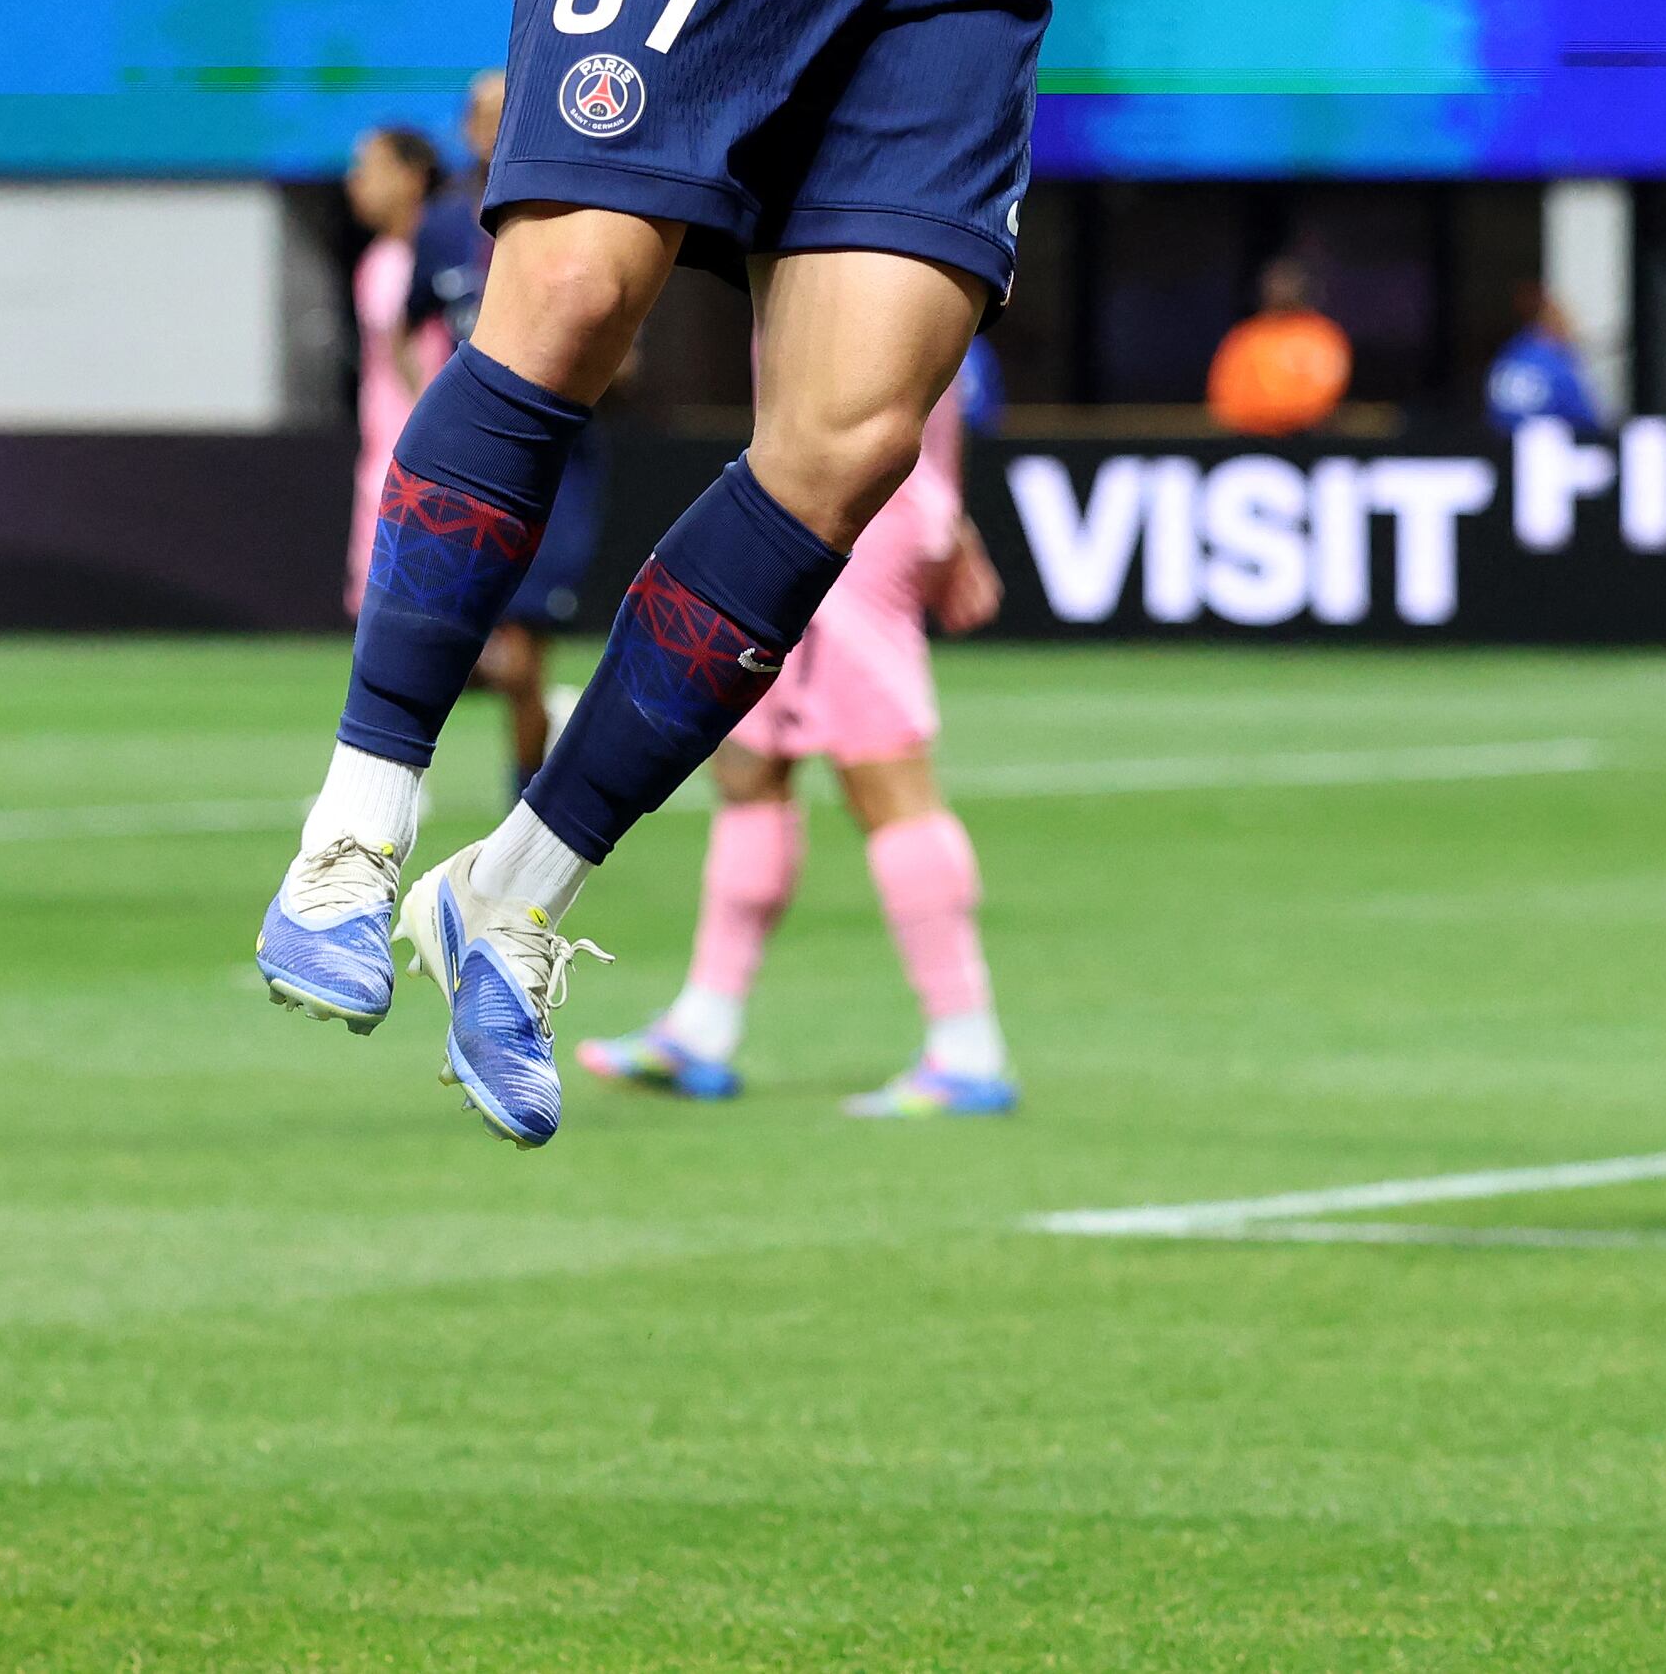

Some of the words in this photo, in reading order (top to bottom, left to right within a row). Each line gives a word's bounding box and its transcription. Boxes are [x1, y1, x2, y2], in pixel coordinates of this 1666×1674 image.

[579, 58, 635, 84] PARIS
[569, 108, 589, 126] SAINT
[592, 117, 625, 130] GERMAIN
[1007, 454, 1496, 625] VISIT
